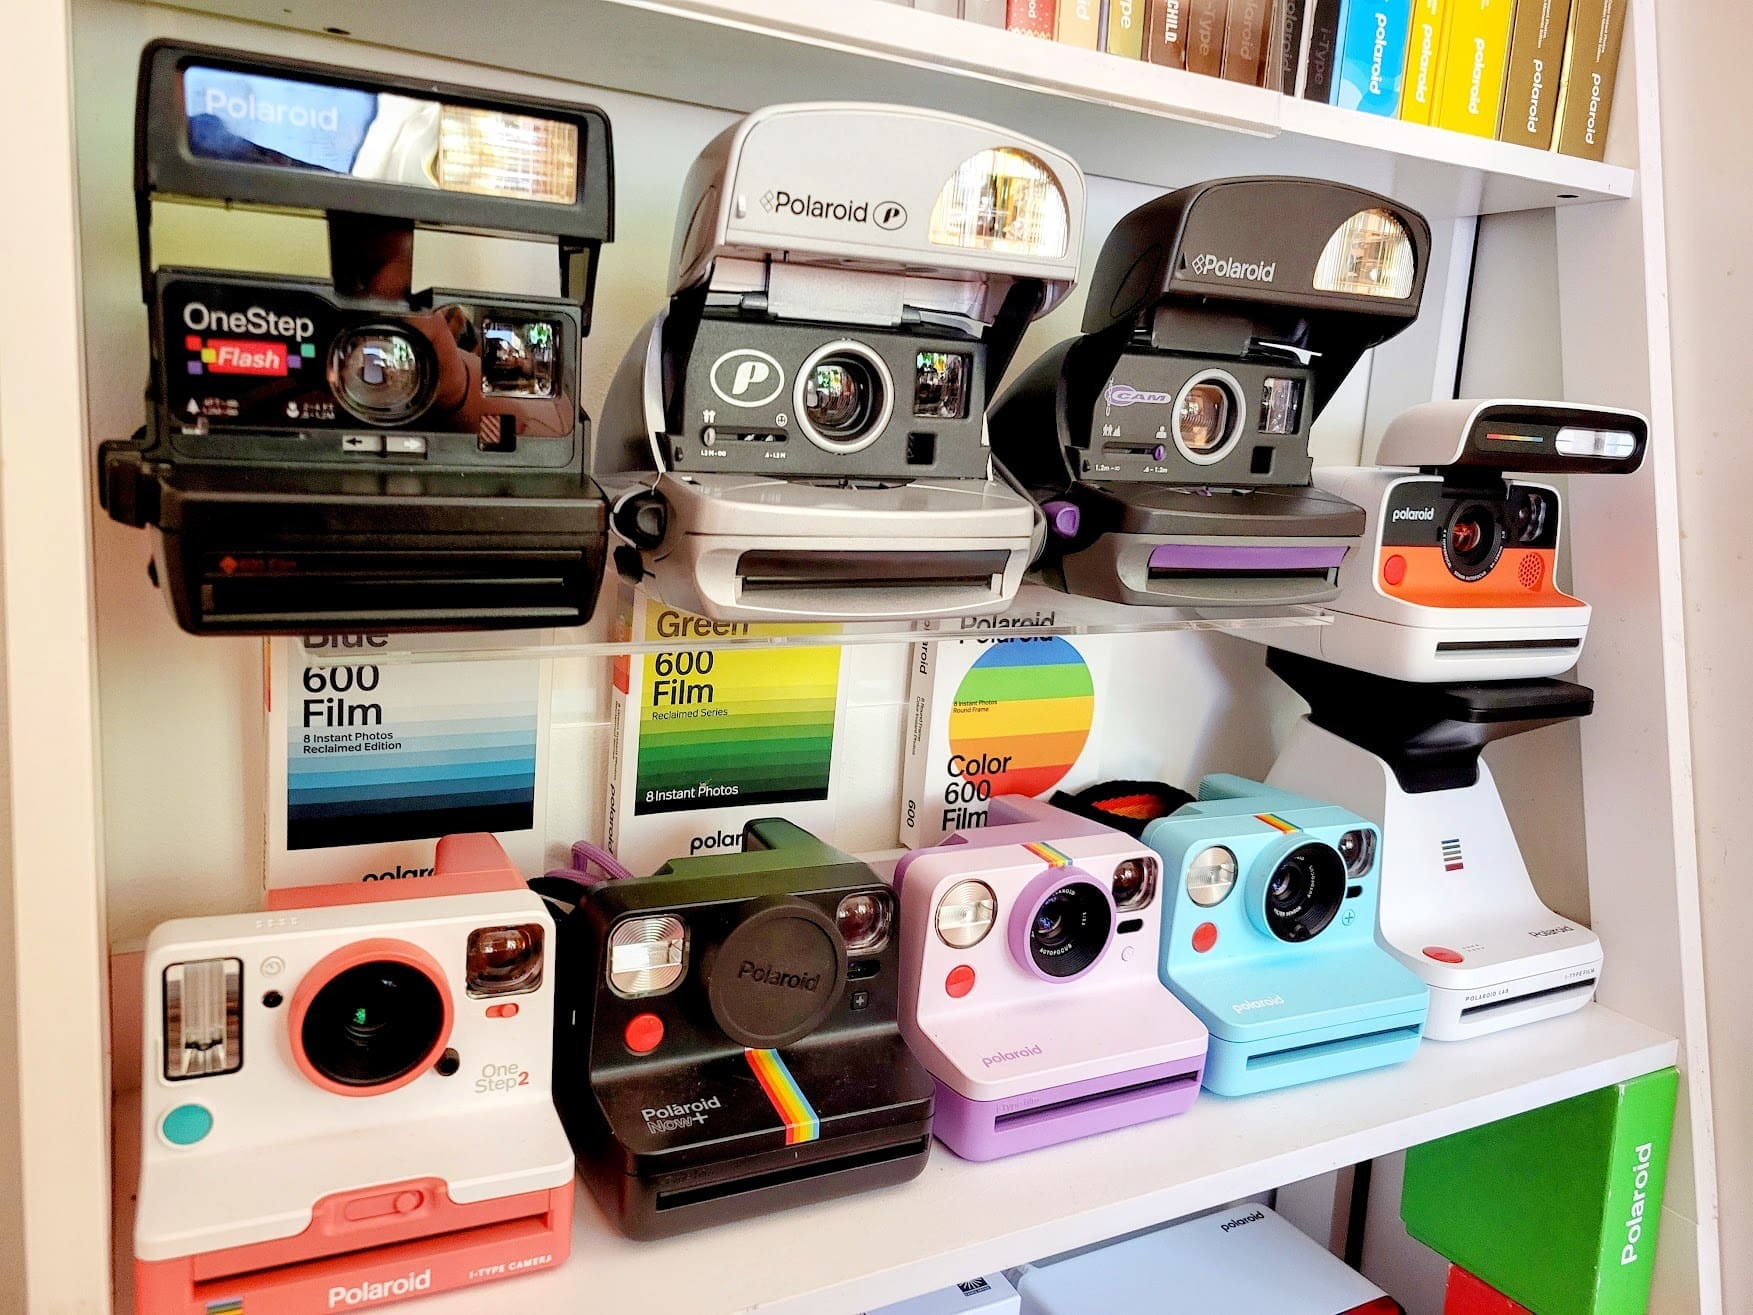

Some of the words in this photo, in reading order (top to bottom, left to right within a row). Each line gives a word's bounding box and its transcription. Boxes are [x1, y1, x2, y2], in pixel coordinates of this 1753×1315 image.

[1369, 12, 1387, 95] polaroid
[1415, 23, 1433, 104] polaroid
[1468, 37, 1485, 115] polaroid
[203, 87, 339, 131] Polaroid
[1527, 59, 1543, 133] polaroid
[1585, 73, 1601, 145] polaroid
[775, 191, 868, 223] Polaroid
[1203, 254, 1276, 282] Polaroid
[183, 301, 315, 342] OneStep
[218, 346, 281, 369] Flash
[1392, 507, 1435, 523] polaroid
[657, 610, 749, 638] Green
[655, 651, 714, 677] 600
[303, 664, 379, 693] 600
[653, 679, 714, 706] Film
[304, 697, 382, 727] Film
[652, 710, 699, 721] Reclaimed
[700, 708, 728, 718] Series
[303, 734, 311, 743] 8
[313, 733, 353, 743] Instant
[355, 731, 394, 741] Photos
[303, 743, 362, 754] Reclaimed
[364, 740, 402, 751] Edition
[947, 753, 1013, 778] Color
[646, 790, 656, 802] 8
[655, 787, 697, 802] Instant
[698, 784, 739, 798] Photos
[944, 779, 991, 804] 600
[607, 783, 616, 855] polaroid
[906, 799, 916, 829] 600
[942, 808, 988, 831] Film
[1528, 925, 1575, 937] Polaroid
[738, 960, 820, 993] Polaroid
[1232, 995, 1285, 1015] polaroid
[1465, 991, 1497, 1002] POLAROID
[1498, 988, 1510, 998] LAB
[982, 1043, 1043, 1069] polaroid
[482, 1063, 519, 1078] One
[641, 1095, 722, 1122] Polaroid
[1620, 1141, 1652, 1266] Polaroid
[1220, 1210, 1265, 1233] polaroid
[508, 1254, 553, 1272] CAMERA
[328, 1268, 432, 1309] Polaroid
